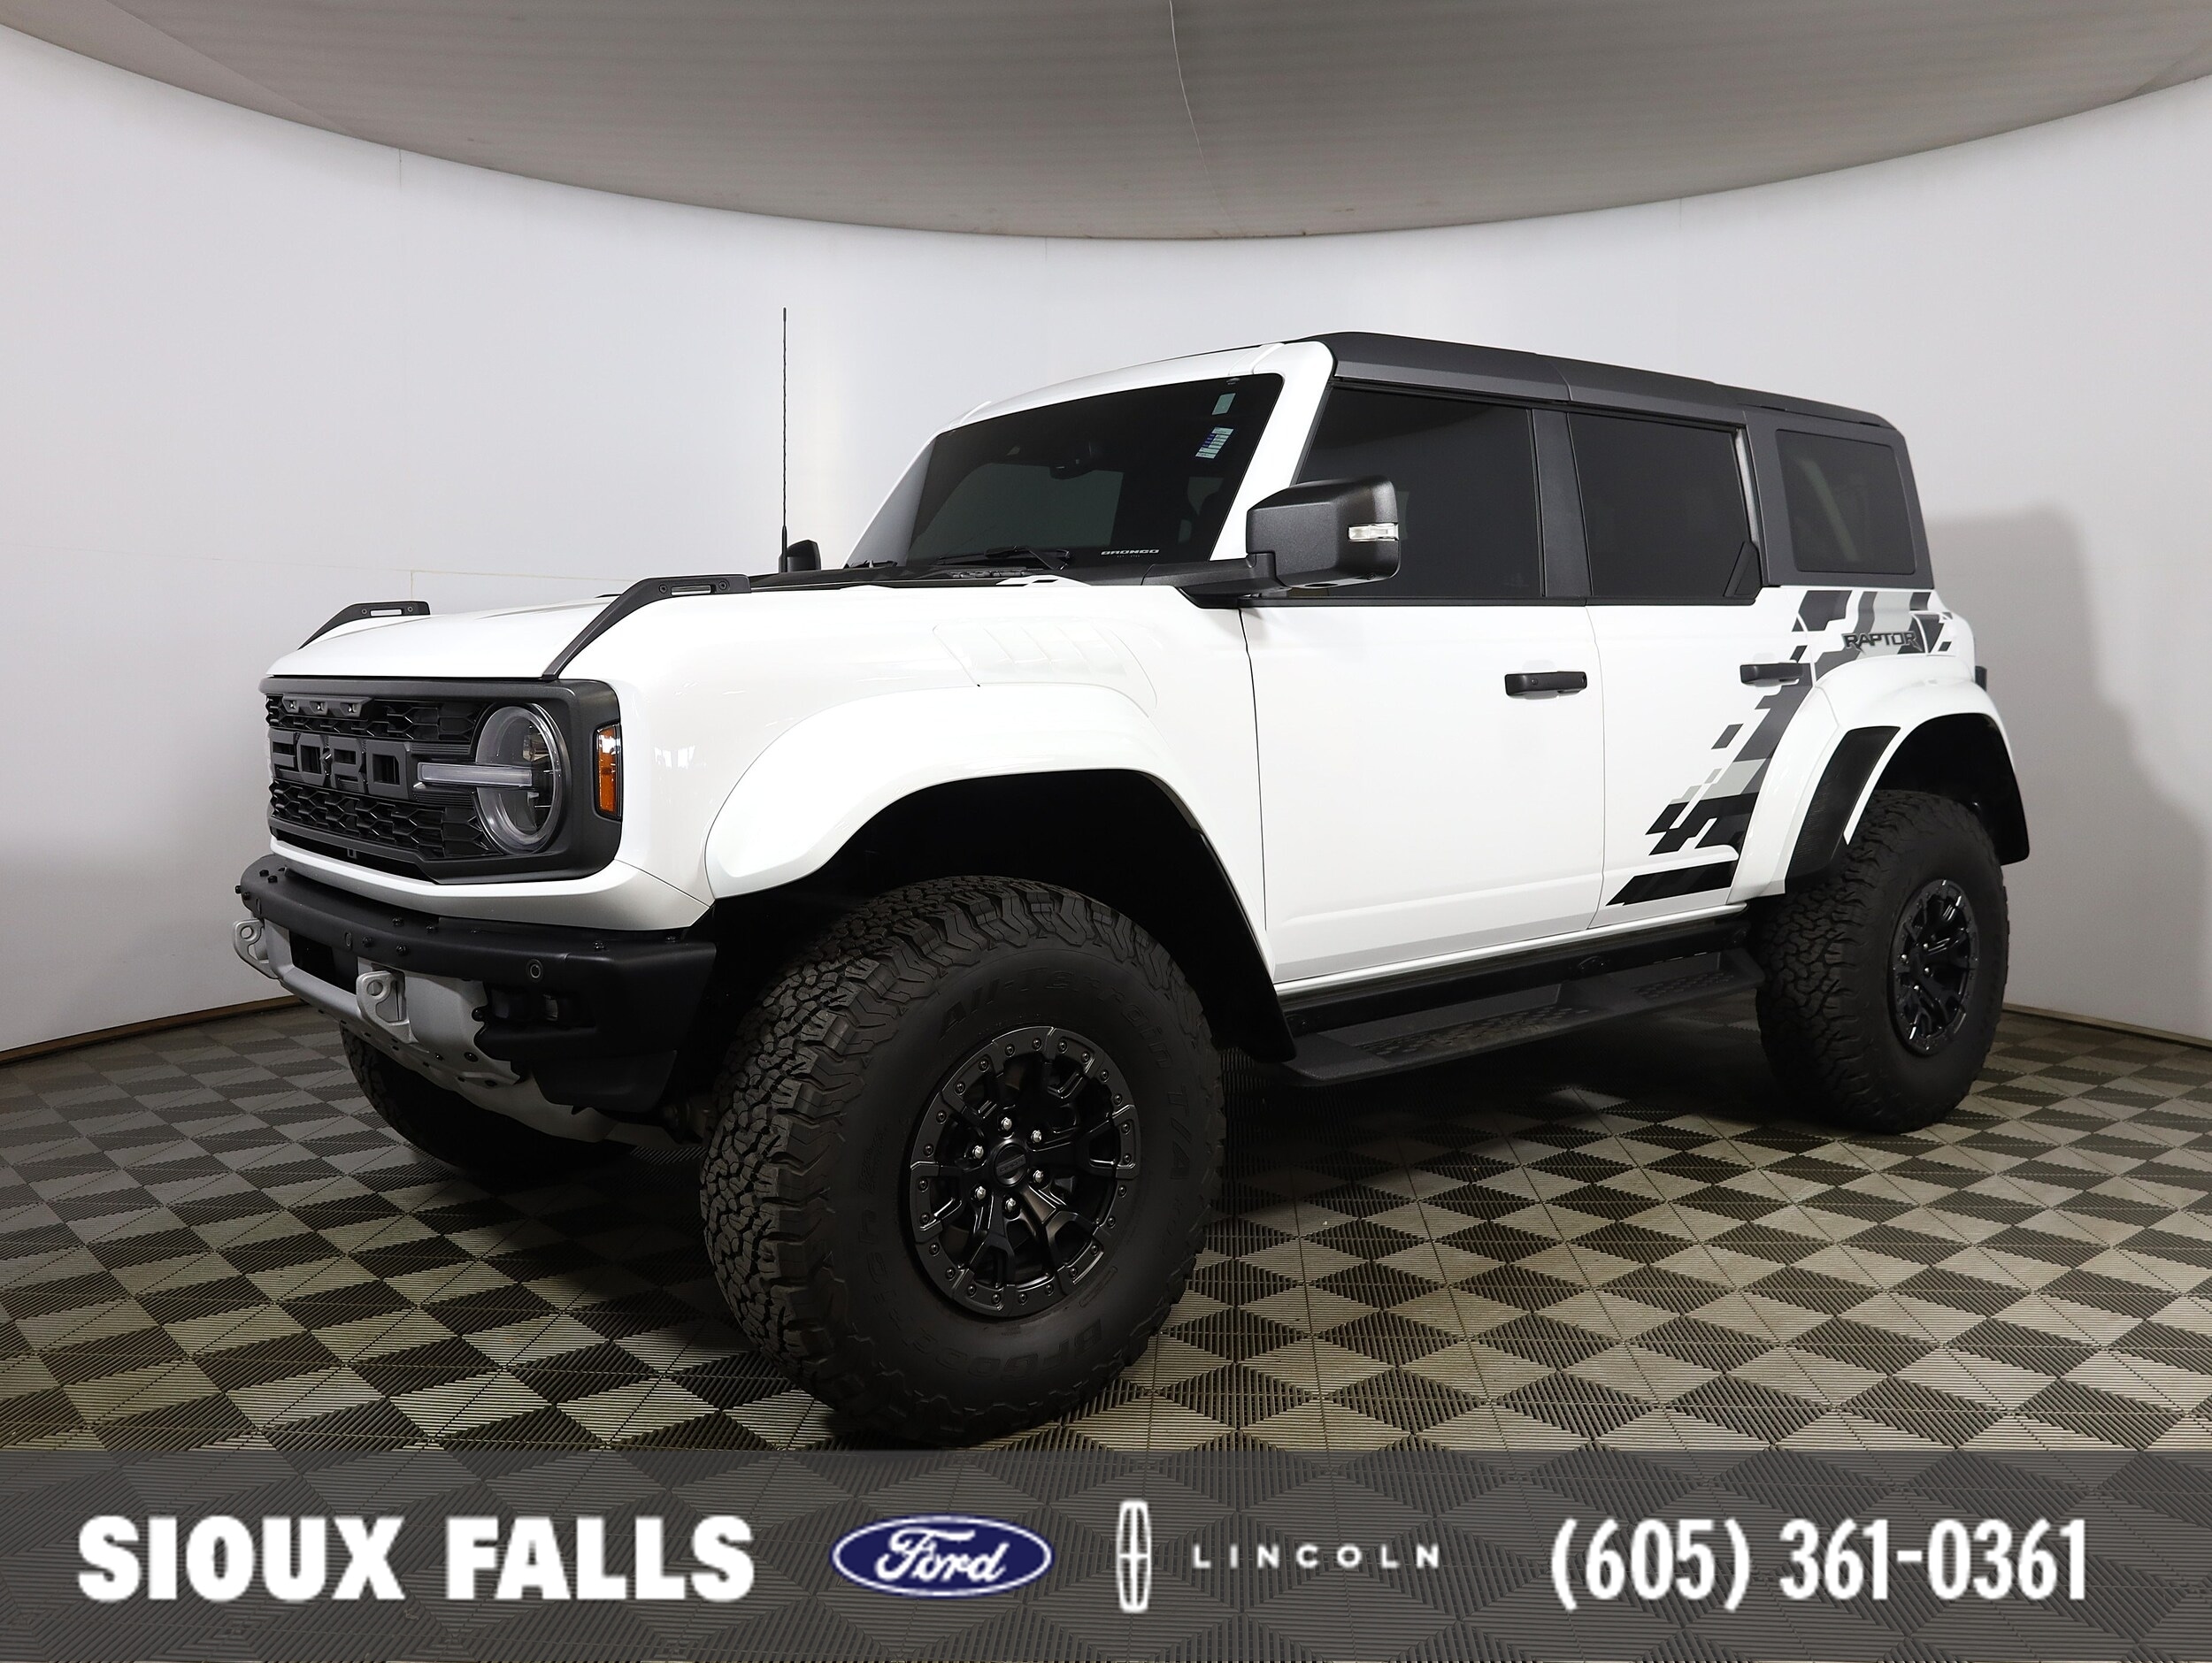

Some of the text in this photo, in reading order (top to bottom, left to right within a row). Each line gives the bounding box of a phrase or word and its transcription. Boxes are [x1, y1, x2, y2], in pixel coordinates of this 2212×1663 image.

[1841, 631, 1923, 653] RAPTOR
[269, 728, 409, 800] FORD
[1167, 1083, 1193, 1180] T/A
